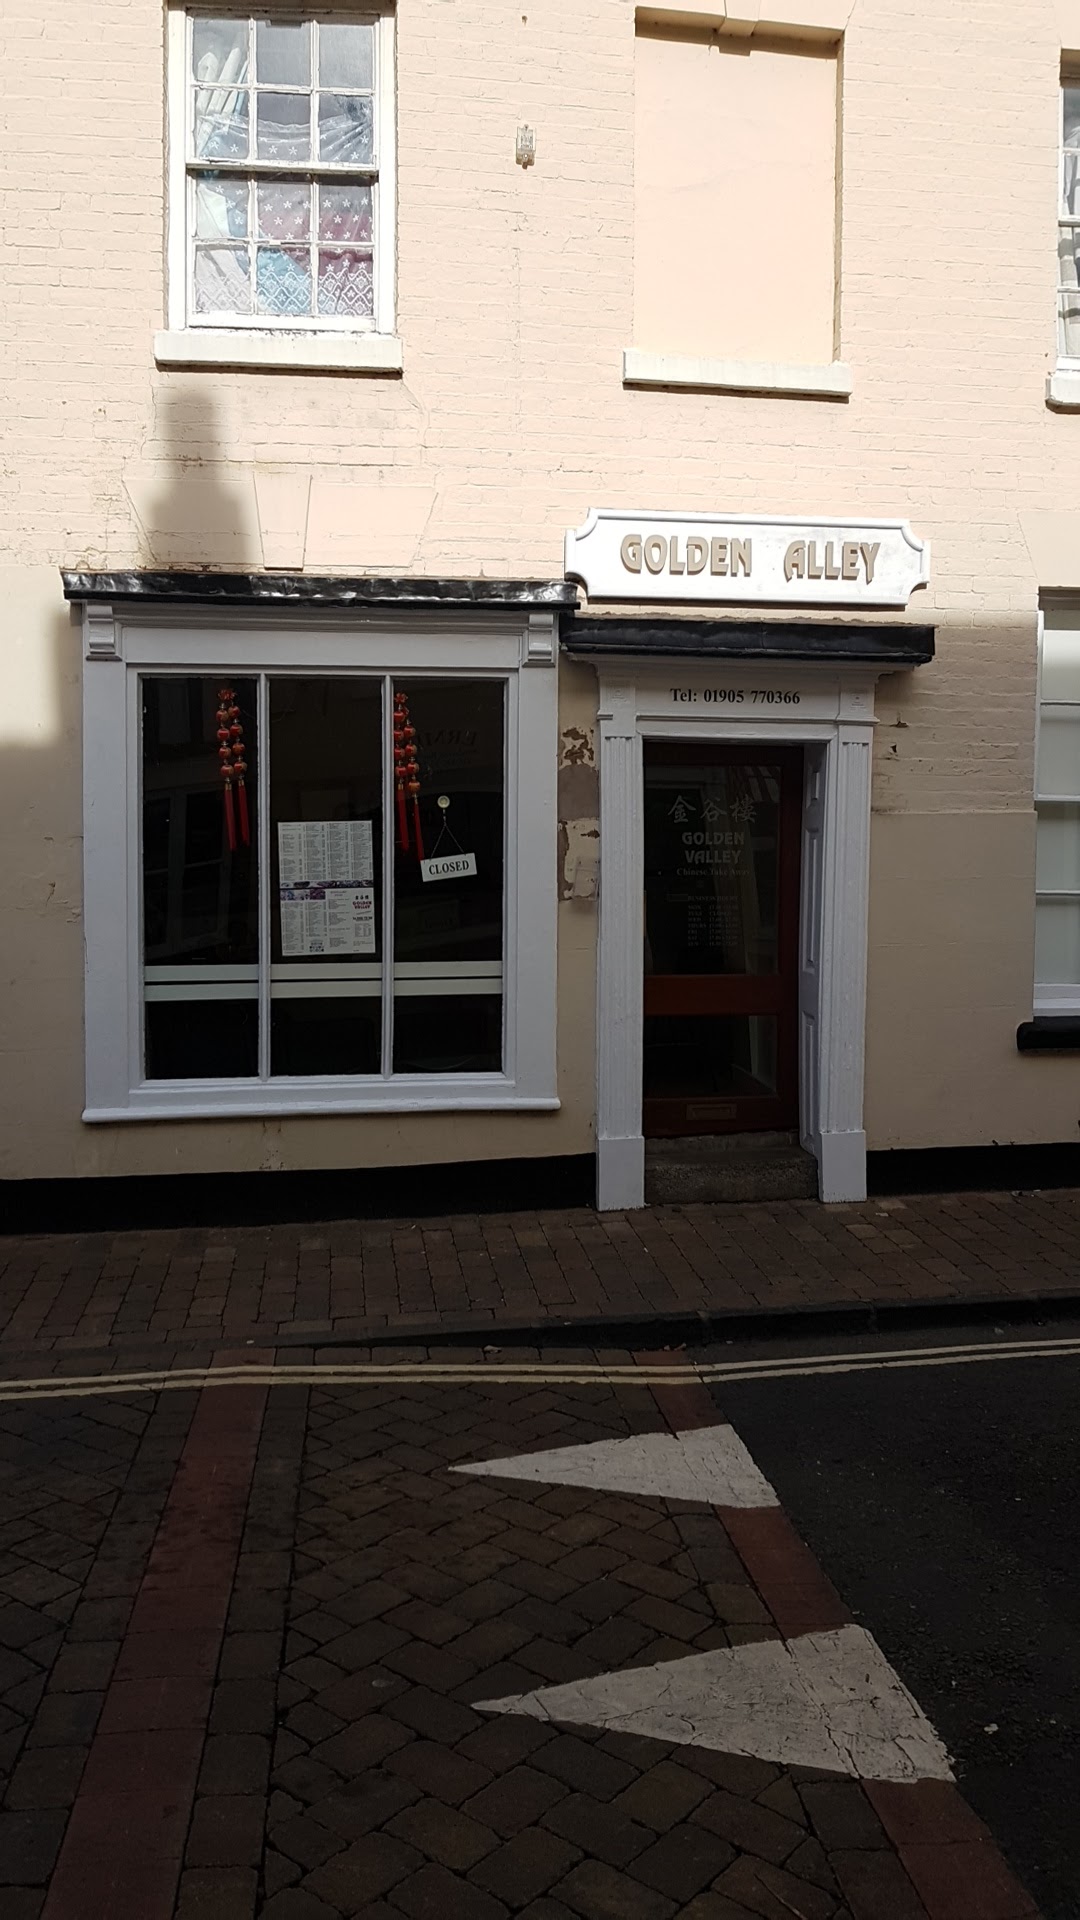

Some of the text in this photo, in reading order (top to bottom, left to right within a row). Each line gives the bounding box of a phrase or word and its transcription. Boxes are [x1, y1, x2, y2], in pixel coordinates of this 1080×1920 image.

[620, 534, 881, 585] GOLDEN ALLEY
[670, 688, 800, 704] Tel: 01905 770366
[681, 831, 745, 845] GOLDEN
[684, 850, 742, 865] VALLEY
[429, 860, 470, 876] CLOSED
[676, 867, 709, 877] Chinese
